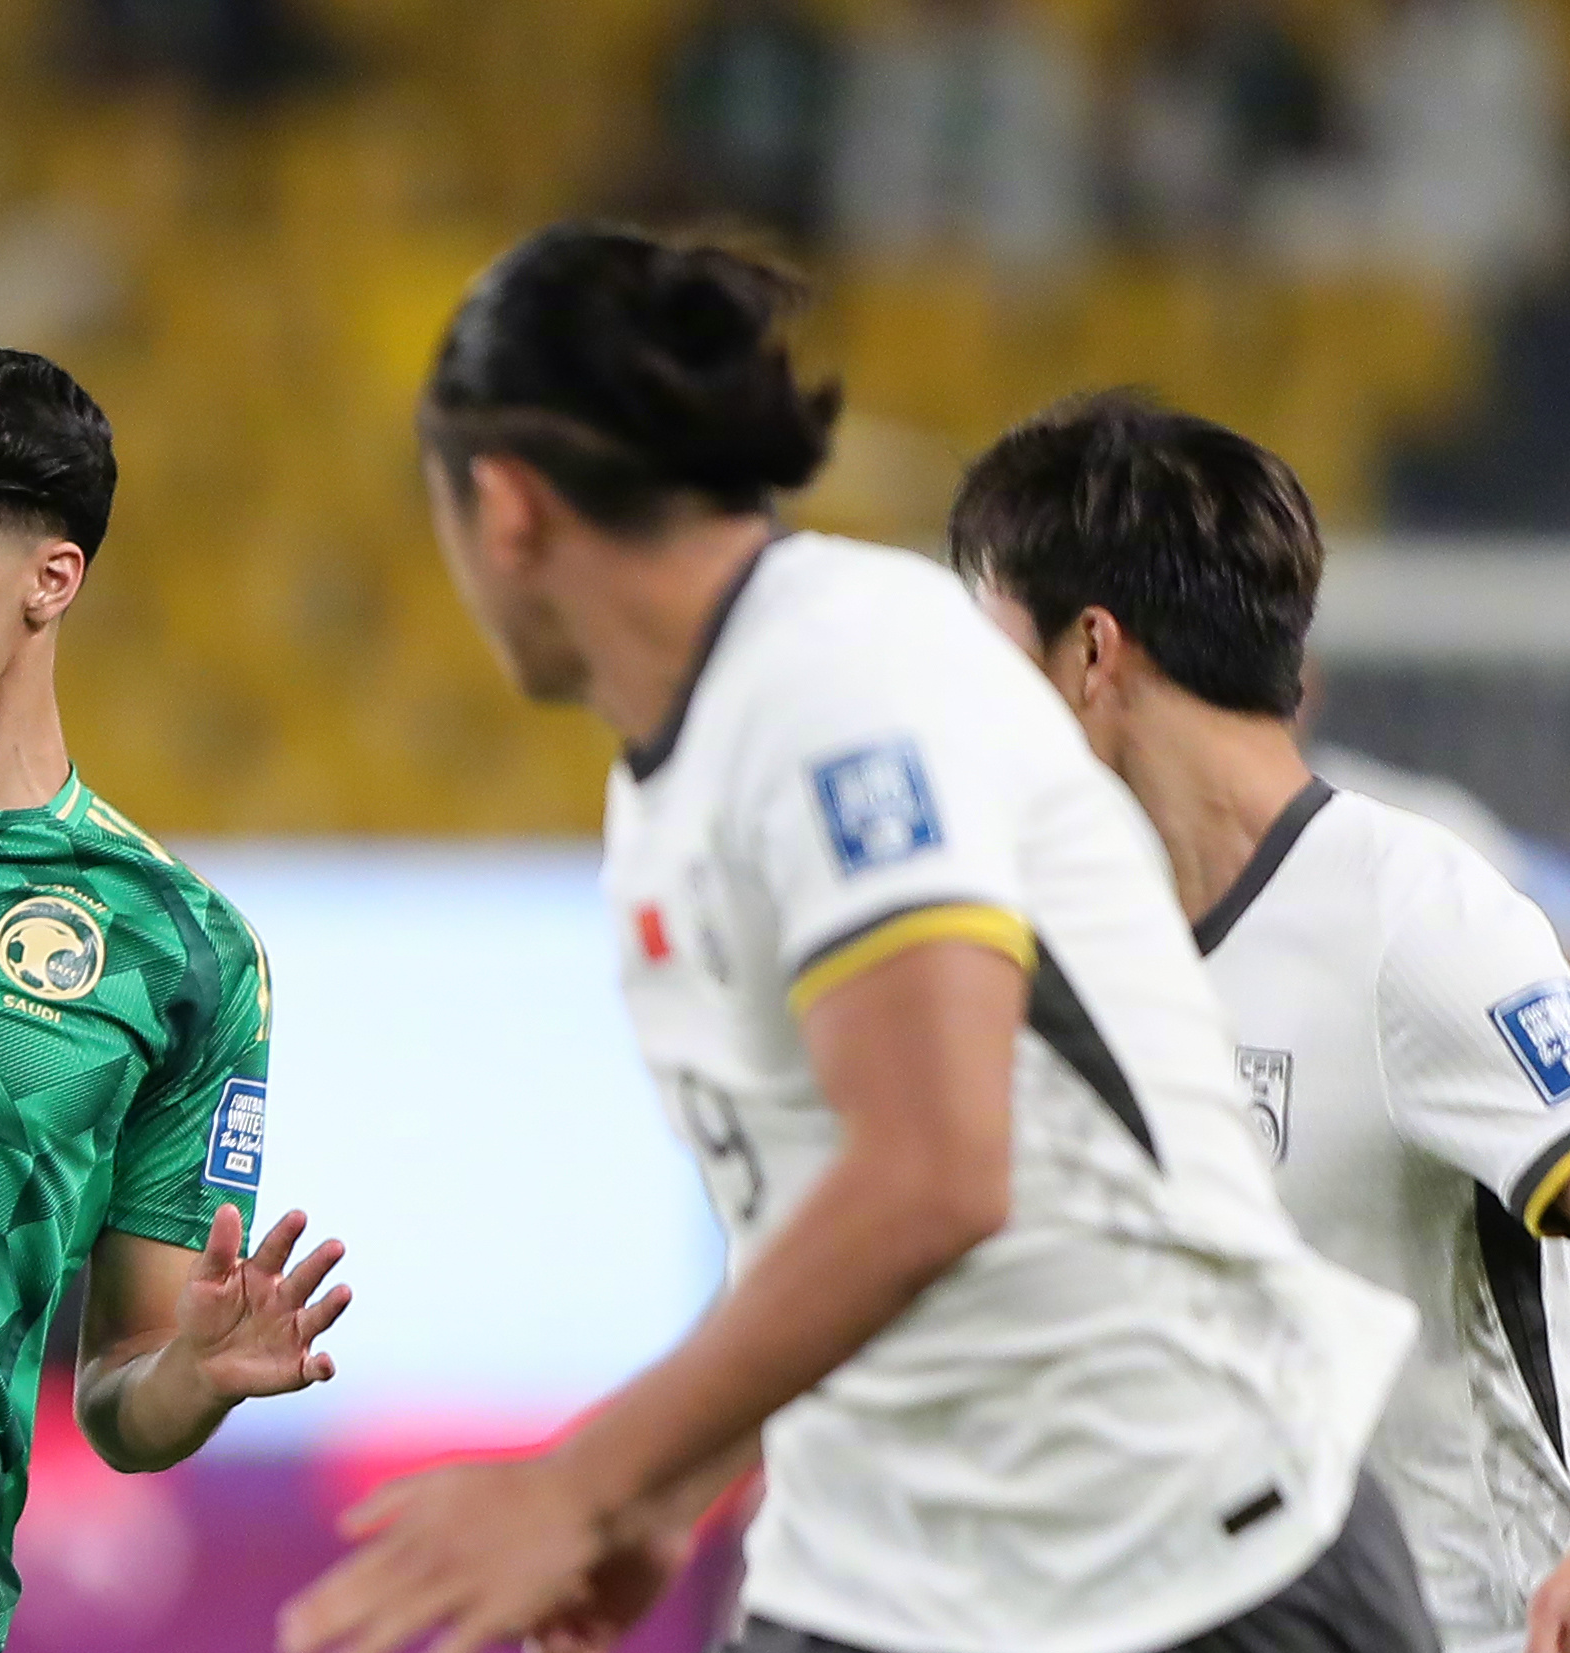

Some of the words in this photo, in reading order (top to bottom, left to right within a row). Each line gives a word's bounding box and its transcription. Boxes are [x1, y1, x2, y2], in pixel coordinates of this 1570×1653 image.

[2, 994, 63, 1023] SAUDI
[675, 1062, 764, 1224] 9
[230, 1157, 248, 1169] FIFA
